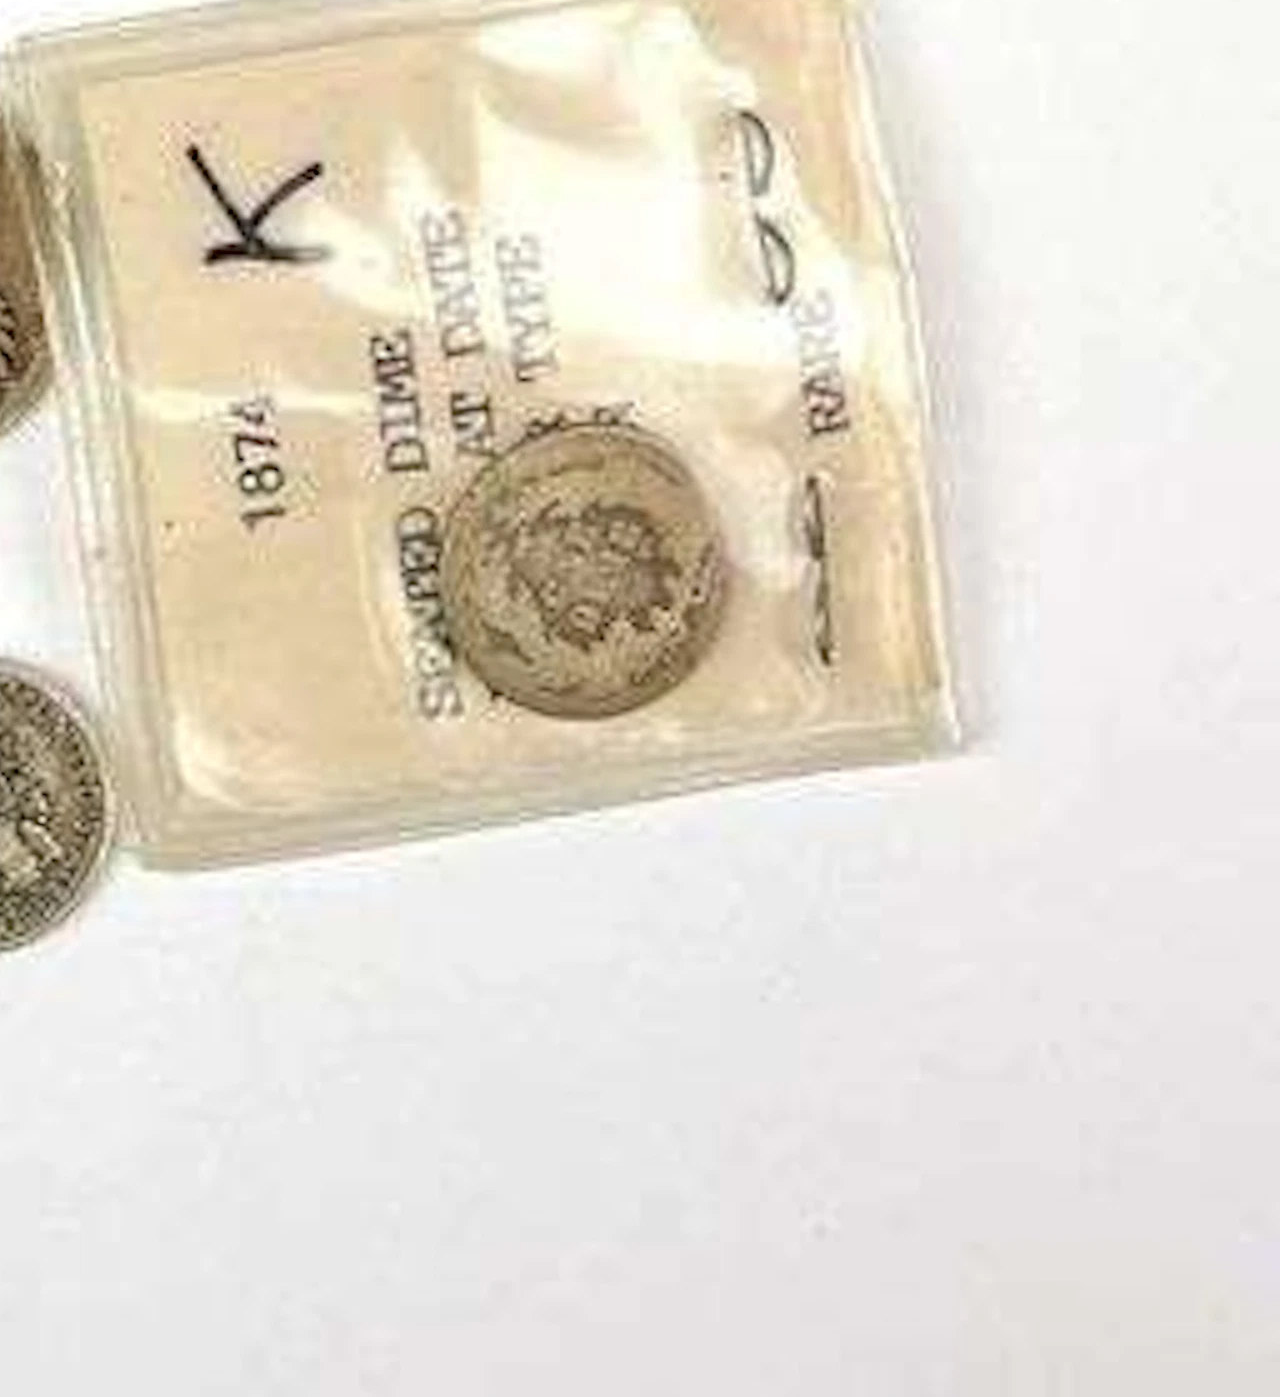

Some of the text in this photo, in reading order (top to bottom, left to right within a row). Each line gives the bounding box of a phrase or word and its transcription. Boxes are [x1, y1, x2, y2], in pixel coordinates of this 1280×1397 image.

[187, 142, 332, 268] K
[419, 206, 493, 364] DATE
[494, 230, 561, 386] TYPE
[790, 284, 852, 440] RARE
[370, 326, 432, 476] DIME
